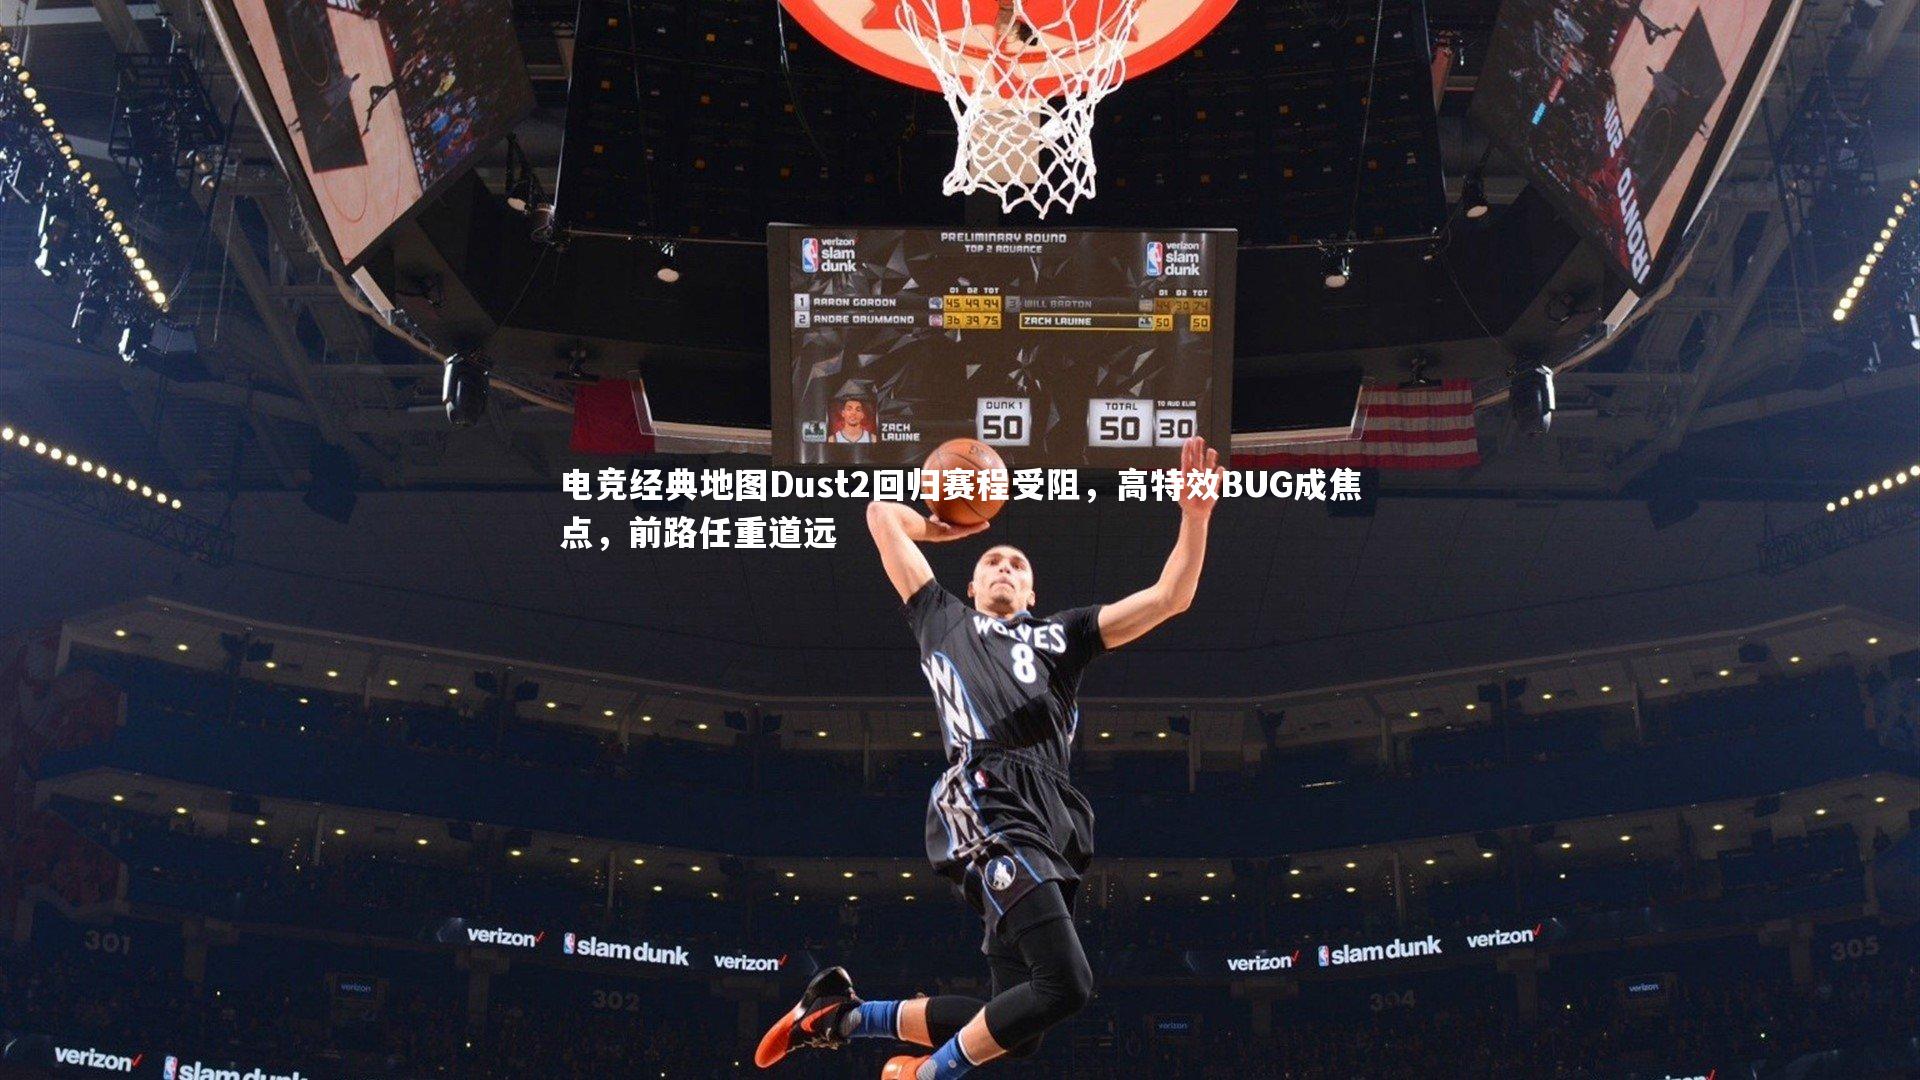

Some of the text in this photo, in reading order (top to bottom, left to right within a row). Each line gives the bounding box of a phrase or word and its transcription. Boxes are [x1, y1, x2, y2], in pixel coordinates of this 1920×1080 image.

[821, 237, 855, 246] verizon
[941, 232, 1067, 243] PRELIMINARY ROUND
[965, 245, 983, 253] TOP
[986, 245, 993, 253] 2
[1166, 241, 1200, 250] verizon
[821, 246, 855, 259] slam
[1166, 250, 1200, 263] slam
[821, 259, 857, 272] dunk
[1165, 263, 1200, 276] dunk
[813, 298, 850, 307] AARON
[853, 298, 897, 307] GORDON
[946, 299, 960, 308] 45
[965, 299, 980, 308] 49
[983, 299, 999, 308] 94
[1023, 299, 1047, 308] WILL
[799, 314, 806, 324] 2
[813, 315, 849, 323] ANDRE
[852, 315, 915, 324] DRUMMOND
[966, 316, 980, 325] 39
[984, 316, 999, 325] 75
[1024, 317, 1052, 326] ZACH
[1156, 318, 1170, 327] 50
[1193, 318, 1208, 327] 50
[986, 401, 1016, 410] DUNK
[1105, 402, 1138, 411] TOTAL
[881, 423, 911, 432] ZACH
[983, 415, 1023, 440] 50
[1100, 416, 1141, 441] 50
[1160, 418, 1193, 438] 30
[1011, 643, 1037, 683] 8
[467, 927, 536, 948] verizon
[1466, 926, 1535, 949] verizon
[577, 935, 690, 967] slam dunk
[1331, 934, 1443, 965] slam dunk
[713, 953, 780, 972] verizon
[1226, 949, 1293, 972] verizon
[1628, 982, 1660, 993] verizon
[54, 1046, 133, 1073] verizon
